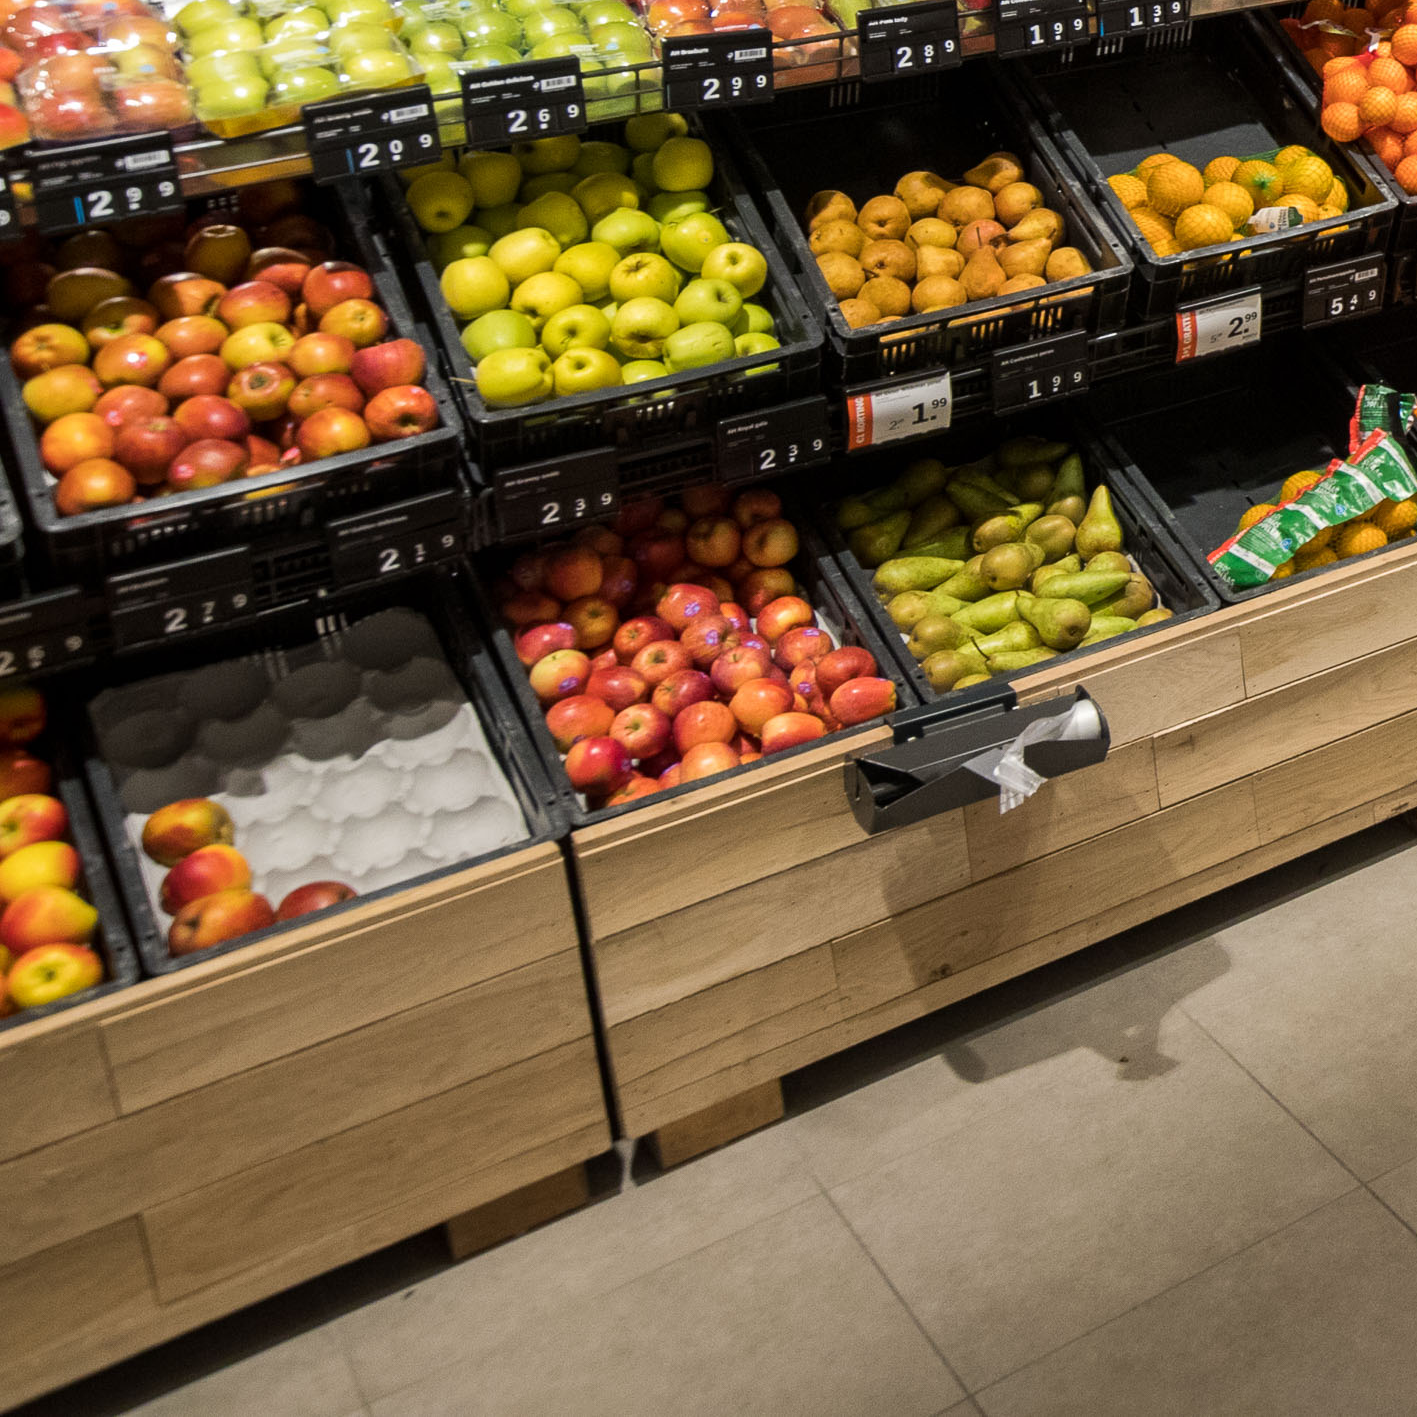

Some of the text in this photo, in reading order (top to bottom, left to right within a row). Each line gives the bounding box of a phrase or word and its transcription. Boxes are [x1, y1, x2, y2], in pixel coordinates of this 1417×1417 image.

[1227, 312, 1258, 339] 2.99
[858, 397, 866, 432] KORTING
[911, 397, 948, 426] 1.99
